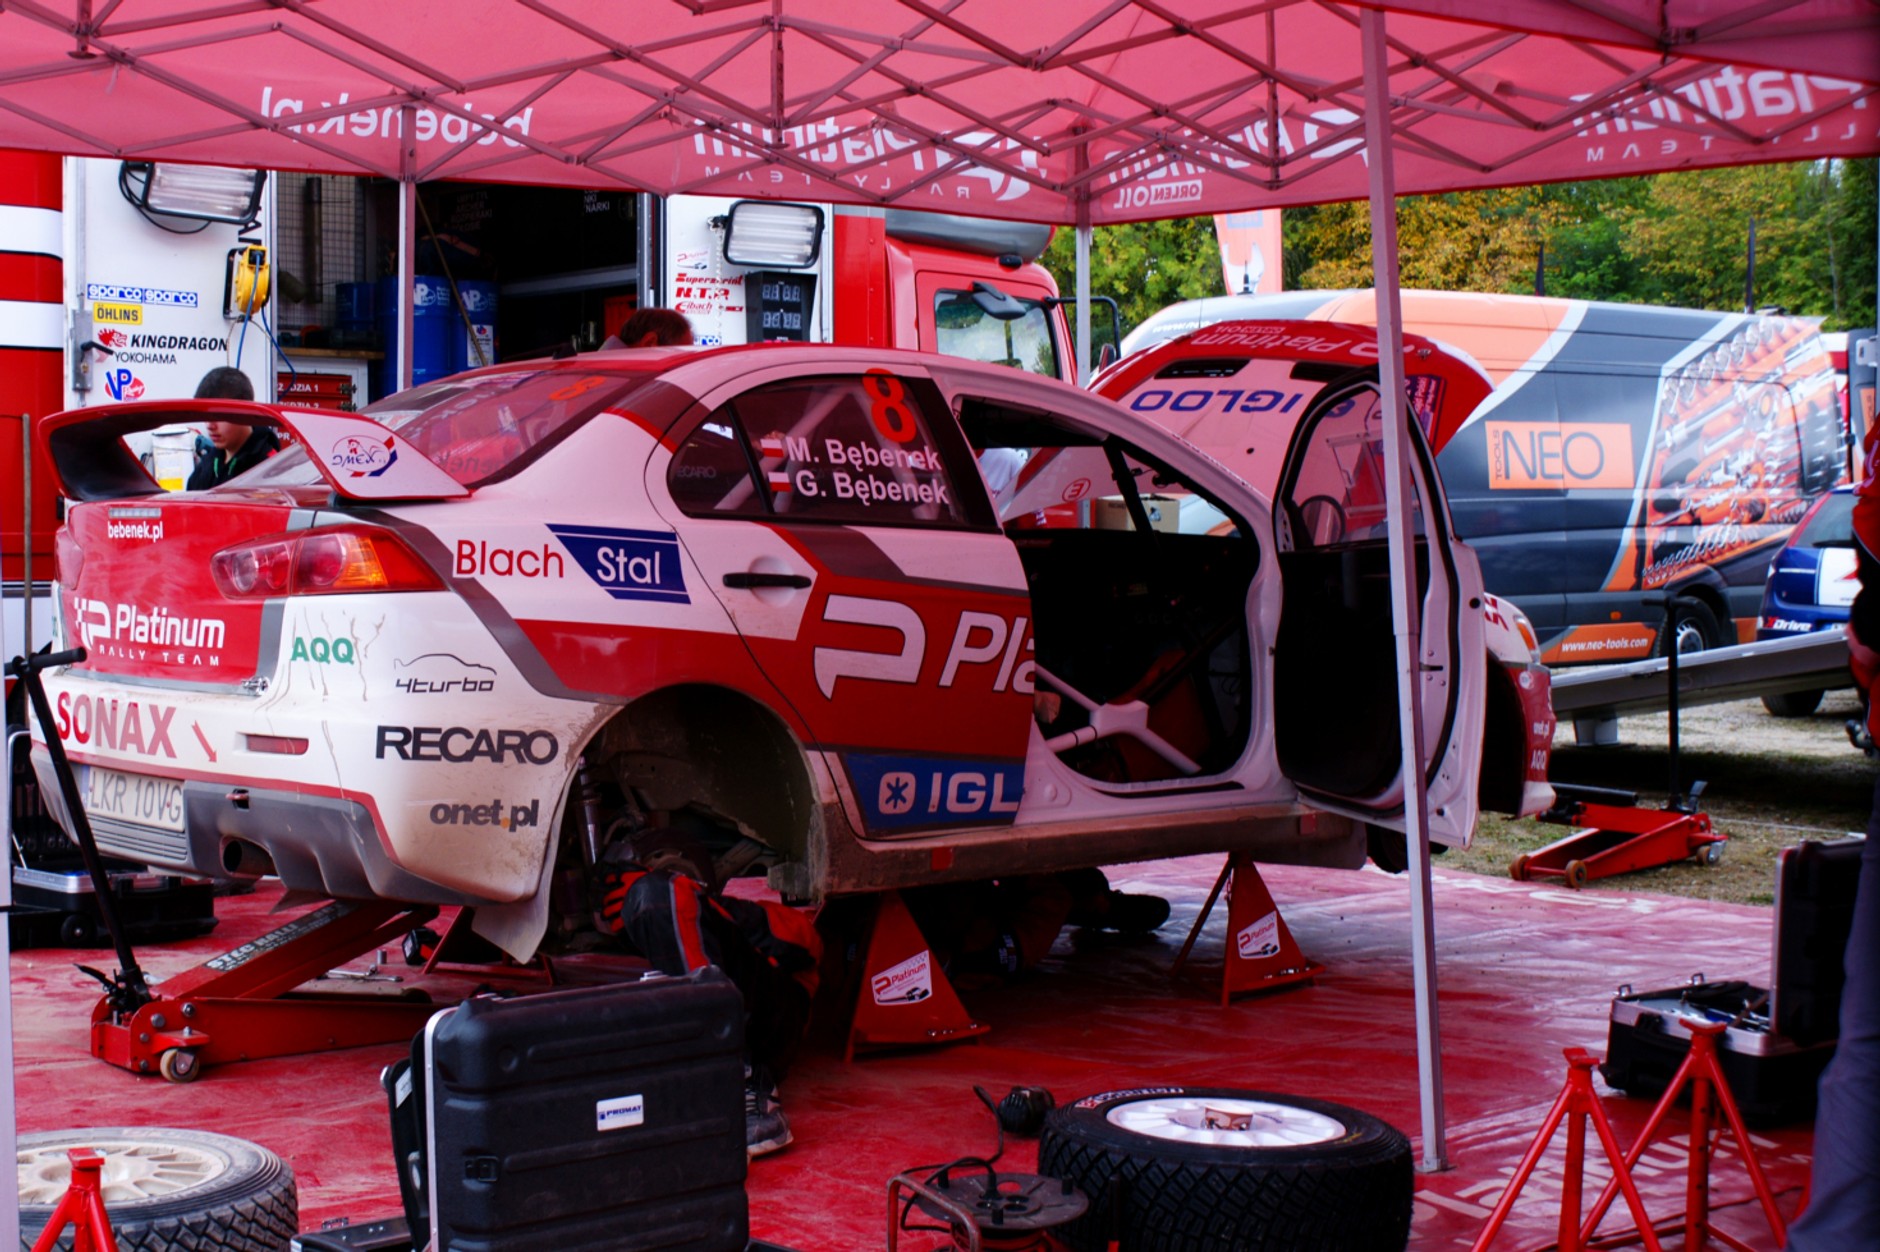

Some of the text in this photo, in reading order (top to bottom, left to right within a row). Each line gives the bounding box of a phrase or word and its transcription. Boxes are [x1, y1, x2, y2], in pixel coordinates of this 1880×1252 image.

[89, 285, 197, 304] sparco sparco
[97, 304, 139, 321] ÖHLINS
[131, 334, 228, 351] KINGDRAGON
[1190, 333, 1353, 353] Platinum
[115, 351, 177, 365] YOKOHAMA
[105, 368, 133, 401] VP
[862, 367, 918, 443] 8
[1130, 390, 1303, 414] IGLOO
[787, 436, 943, 472] M. Bębenek
[1502, 430, 1605, 480] NEO
[795, 470, 949, 506] G. Bębenek
[107, 520, 164, 544] bebenek.pl
[456, 539, 661, 585] Blach Stal
[115, 603, 226, 649] Platinum
[99, 644, 219, 666] RALLY TEAM
[290, 636, 355, 665] AQQ
[1561, 637, 1649, 652] www.neo-tools.com
[396, 676, 495, 693] 4turbo
[56, 690, 178, 759] SONAX
[375, 725, 559, 765] RECARO
[1531, 750, 1547, 770] AQQ
[89, 770, 128, 814] LKR
[928, 771, 1020, 813] IGL
[429, 799, 540, 833] onet.pl
[891, 962, 926, 984] Platinum
